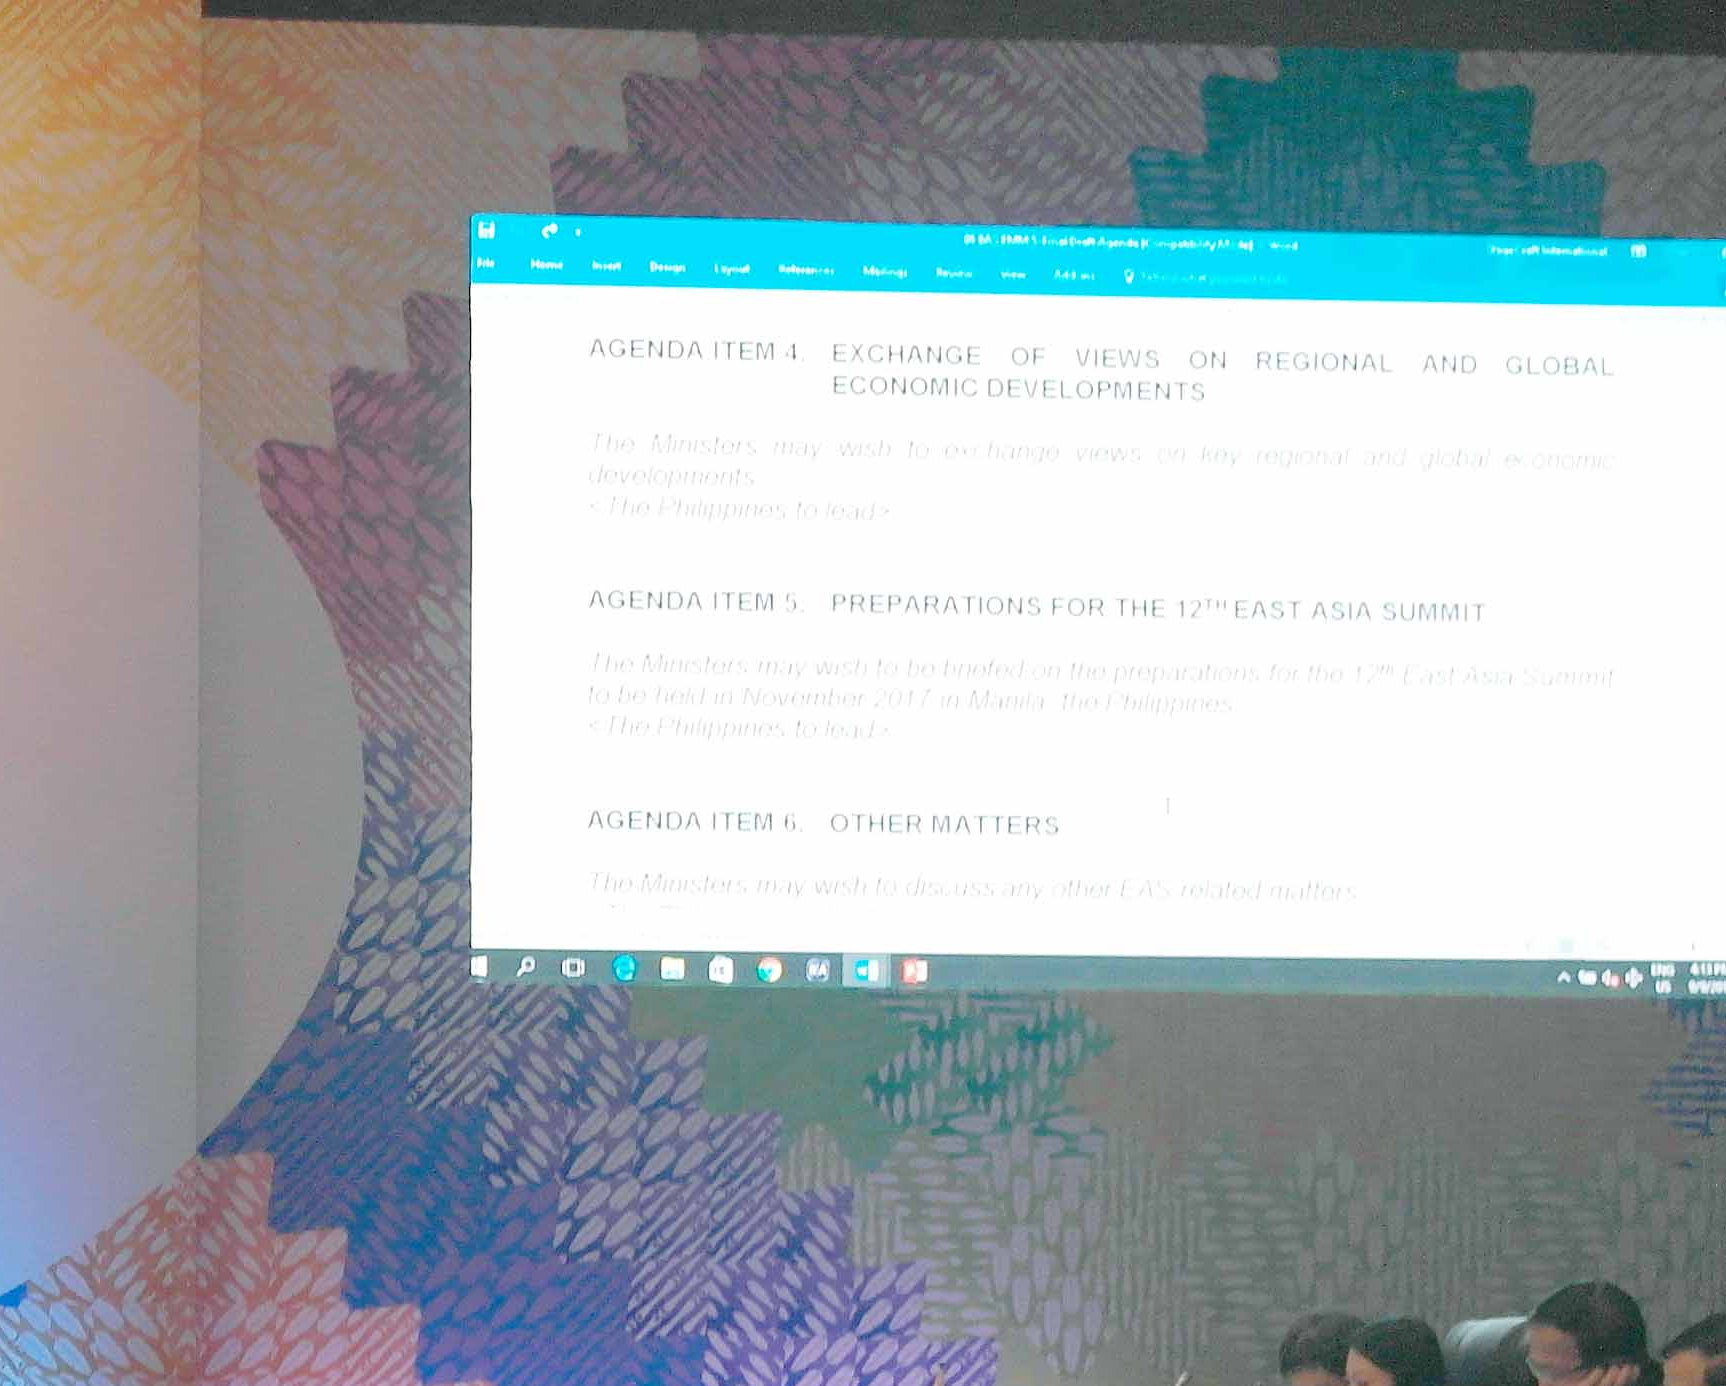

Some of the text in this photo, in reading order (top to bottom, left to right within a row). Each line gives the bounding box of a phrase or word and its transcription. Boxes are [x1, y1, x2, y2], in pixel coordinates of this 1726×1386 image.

[530, 259, 564, 271] Home
[649, 260, 687, 274] Design
[590, 339, 702, 358] AGENDA
[715, 342, 774, 360] ITEM
[833, 344, 980, 364] EXCHANGE
[1012, 348, 1044, 365] OF
[1076, 349, 1159, 368] VIEWS
[1190, 351, 1225, 368] ON
[1257, 352, 1390, 372] REGIONAL
[1424, 355, 1476, 373] AND
[1506, 357, 1612, 375] GLOBAL
[834, 376, 1204, 400] ECONOMIC DEVELOPMENTS
[589, 591, 702, 609] AGENDA
[714, 592, 773, 611] ITEM
[833, 594, 1040, 614] PREPARATIONS
[1052, 598, 1103, 616] FOR
[1116, 599, 1164, 617] THE
[1234, 600, 1301, 620] EAST
[1312, 602, 1371, 620] ASIA
[1383, 603, 1486, 622] SUMMIT
[588, 811, 700, 830] AGENDA
[713, 813, 772, 831] ITEM
[831, 814, 921, 832] OTHER
[933, 816, 1058, 833] MATTERS
